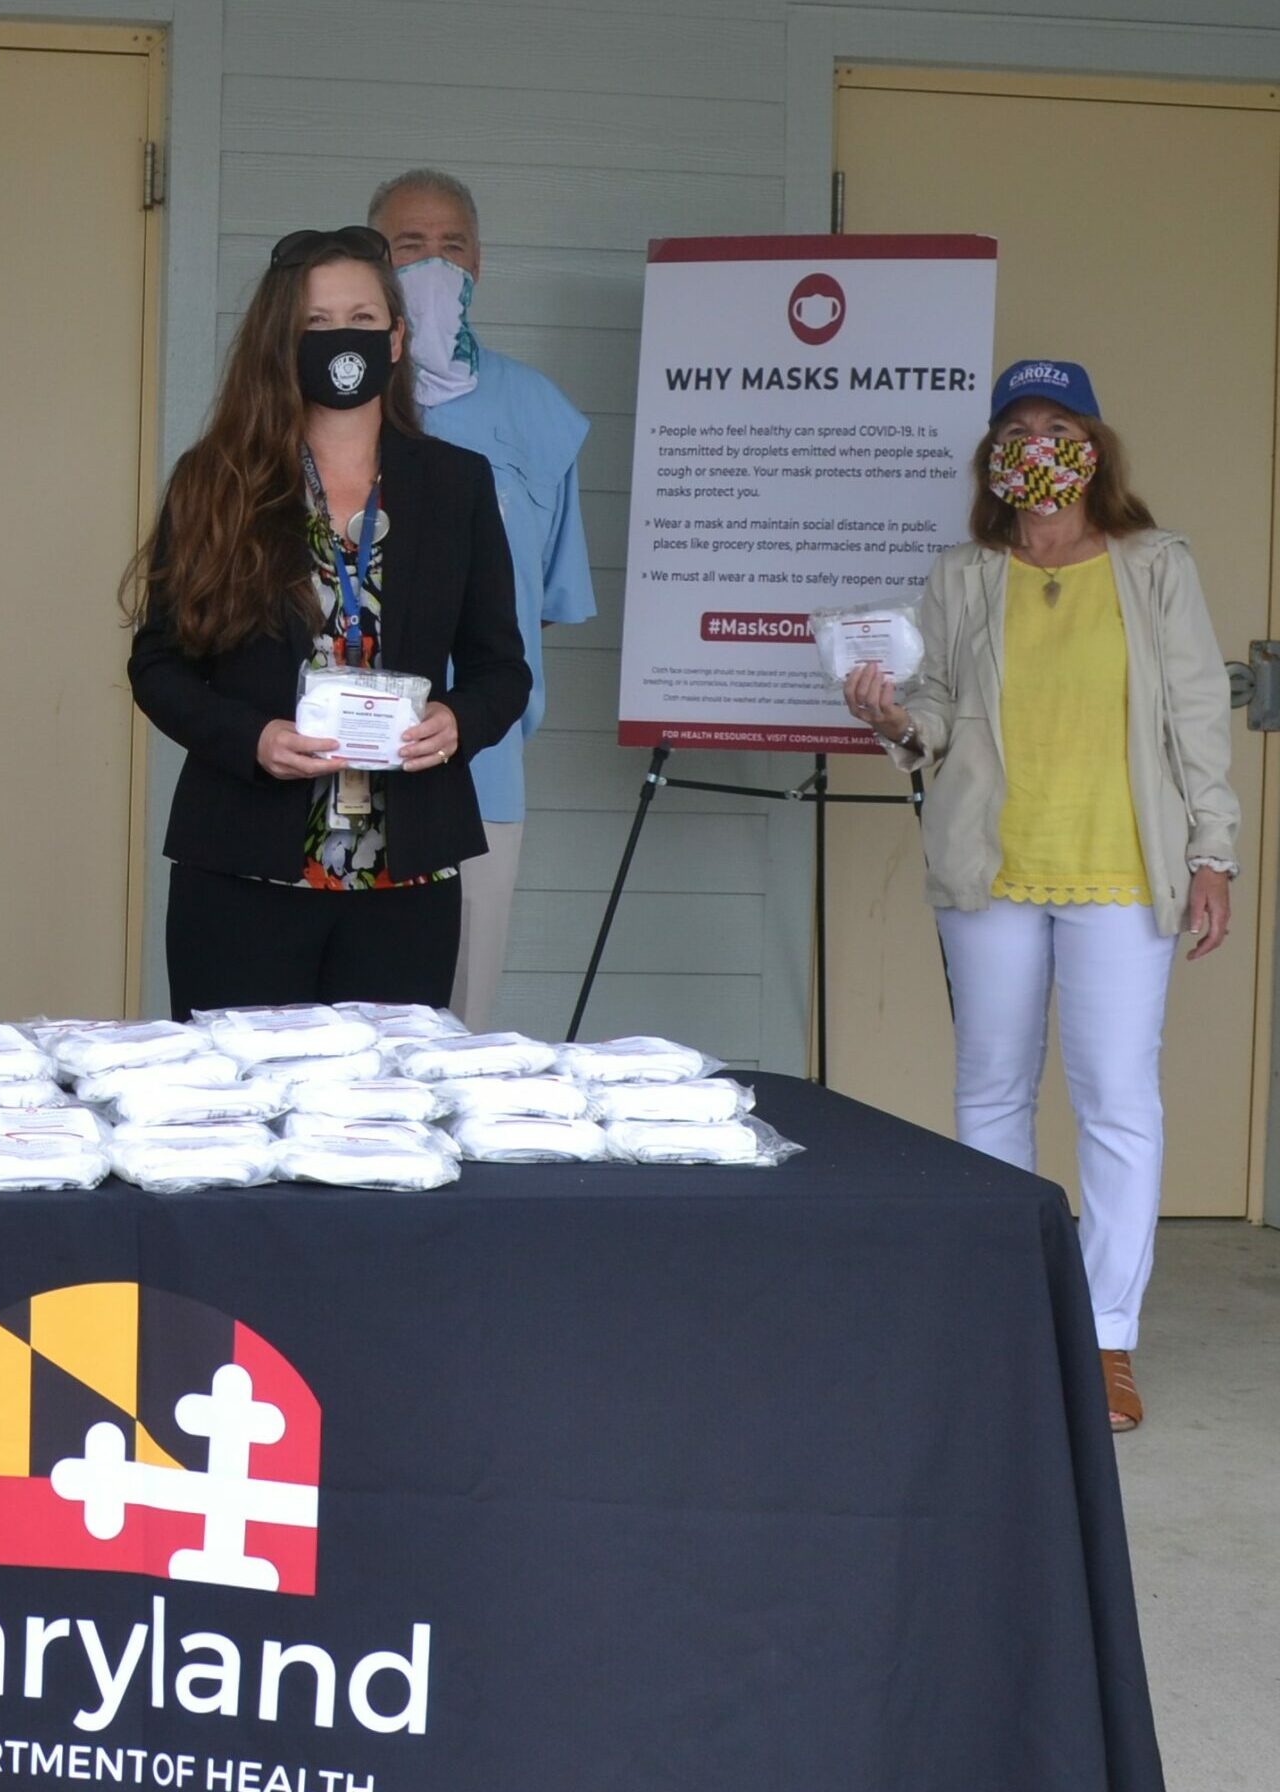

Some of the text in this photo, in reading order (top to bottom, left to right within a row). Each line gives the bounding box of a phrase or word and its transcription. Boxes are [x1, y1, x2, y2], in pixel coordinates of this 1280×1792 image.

[665, 366, 975, 391] WHY MASKS MATTER:
[658, 424, 938, 439] People who feel healthy can spread COVID-19. It is
[658, 443, 953, 460] transmitted by droplets emitted when people speak,
[656, 465, 957, 480] cough or sneeze. Your mask protects others and their
[655, 485, 760, 500] masks protect you.
[652, 517, 937, 534] Wear a mask and maintain social distance in public
[652, 537, 688, 551] places
[689, 537, 710, 550] like
[711, 539, 755, 553] grocery
[756, 539, 793, 551] stores,
[794, 538, 862, 552] pharmacies
[863, 540, 887, 552] and
[888, 540, 924, 554] public
[649, 569, 669, 582] We
[670, 571, 700, 582] must
[701, 570, 715, 582] all
[717, 572, 746, 582] wear
[747, 572, 755, 583] a
[757, 571, 788, 583] mask
[790, 572, 804, 583] to
[804, 571, 839, 587] safely
[840, 574, 882, 587] reopen
[884, 575, 905, 586] our
[680, 730, 713, 740] HEALTH
[713, 731, 765, 742] RESOURCES,
[765, 733, 788, 742] VISIT
[153, 1753, 195, 1788] OF
